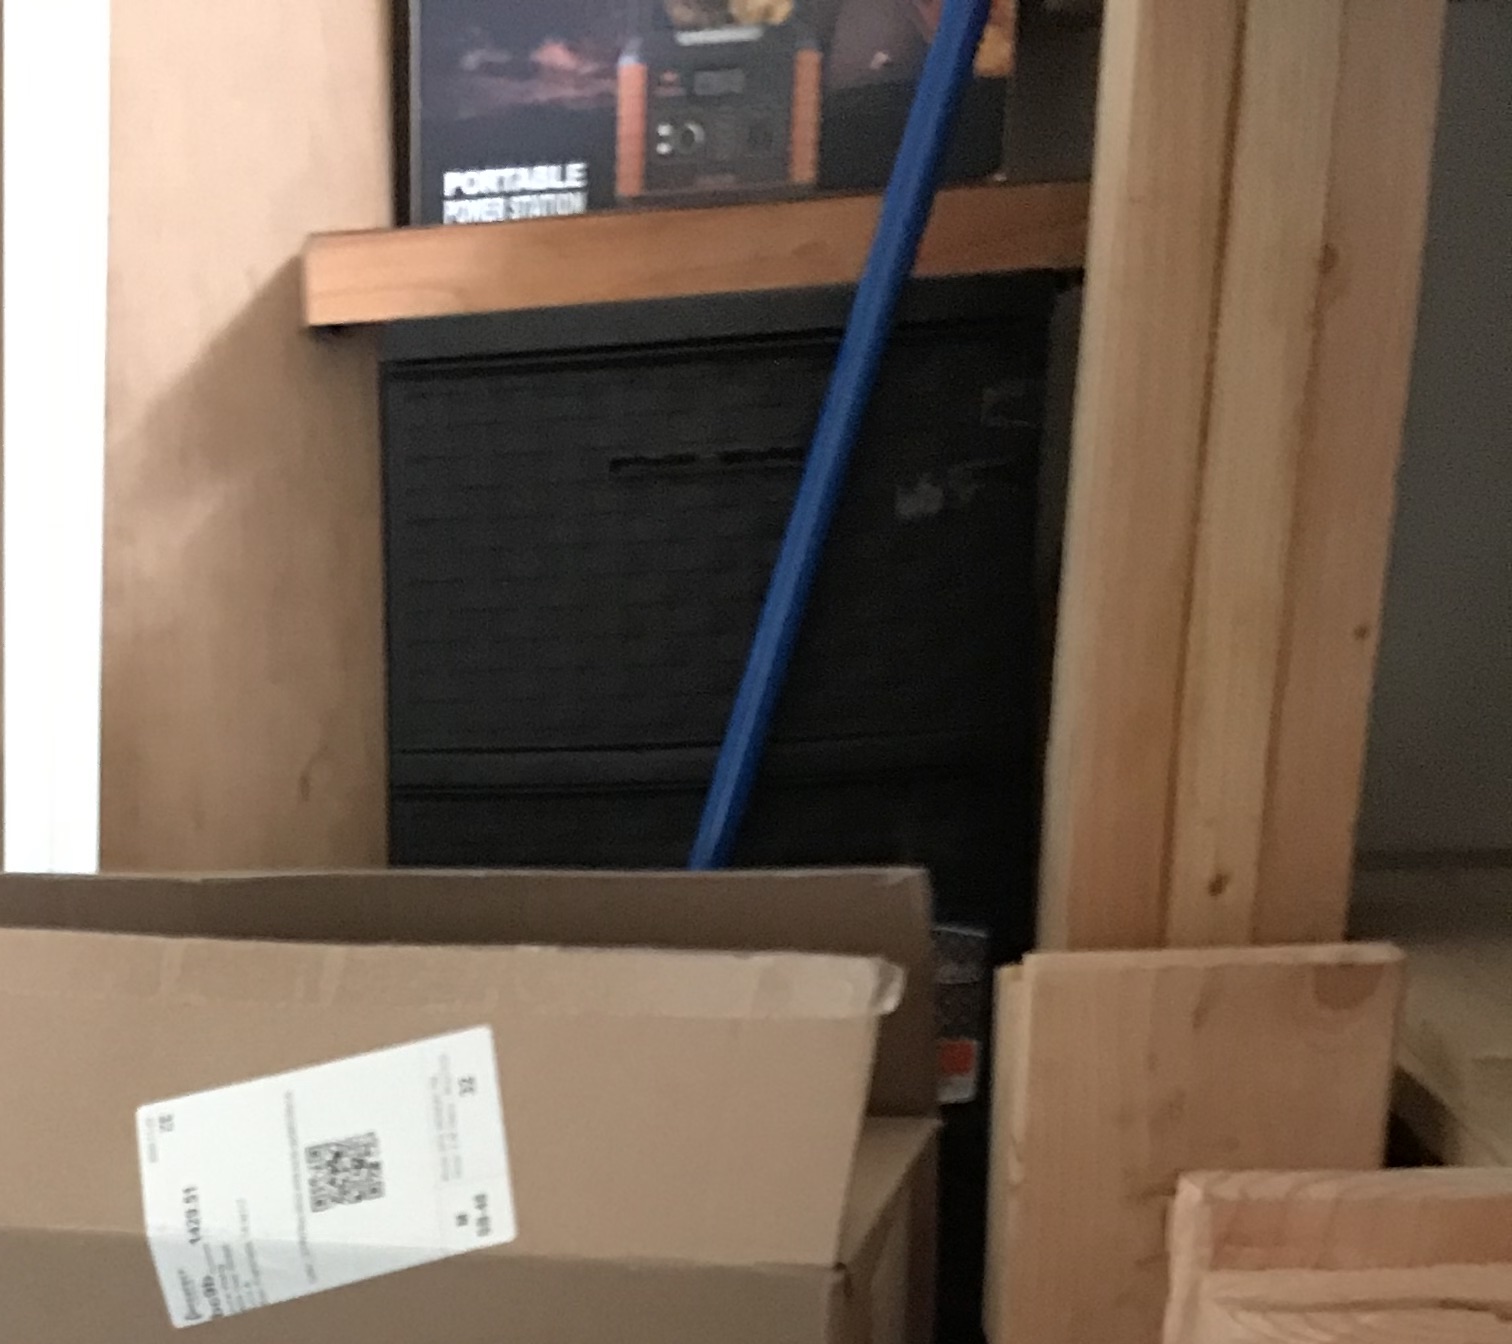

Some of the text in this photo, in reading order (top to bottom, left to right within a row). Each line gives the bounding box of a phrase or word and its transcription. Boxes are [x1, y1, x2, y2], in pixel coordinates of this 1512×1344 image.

[443, 163, 587, 196] PORTABLE
[443, 192, 587, 224] POWER STATION
